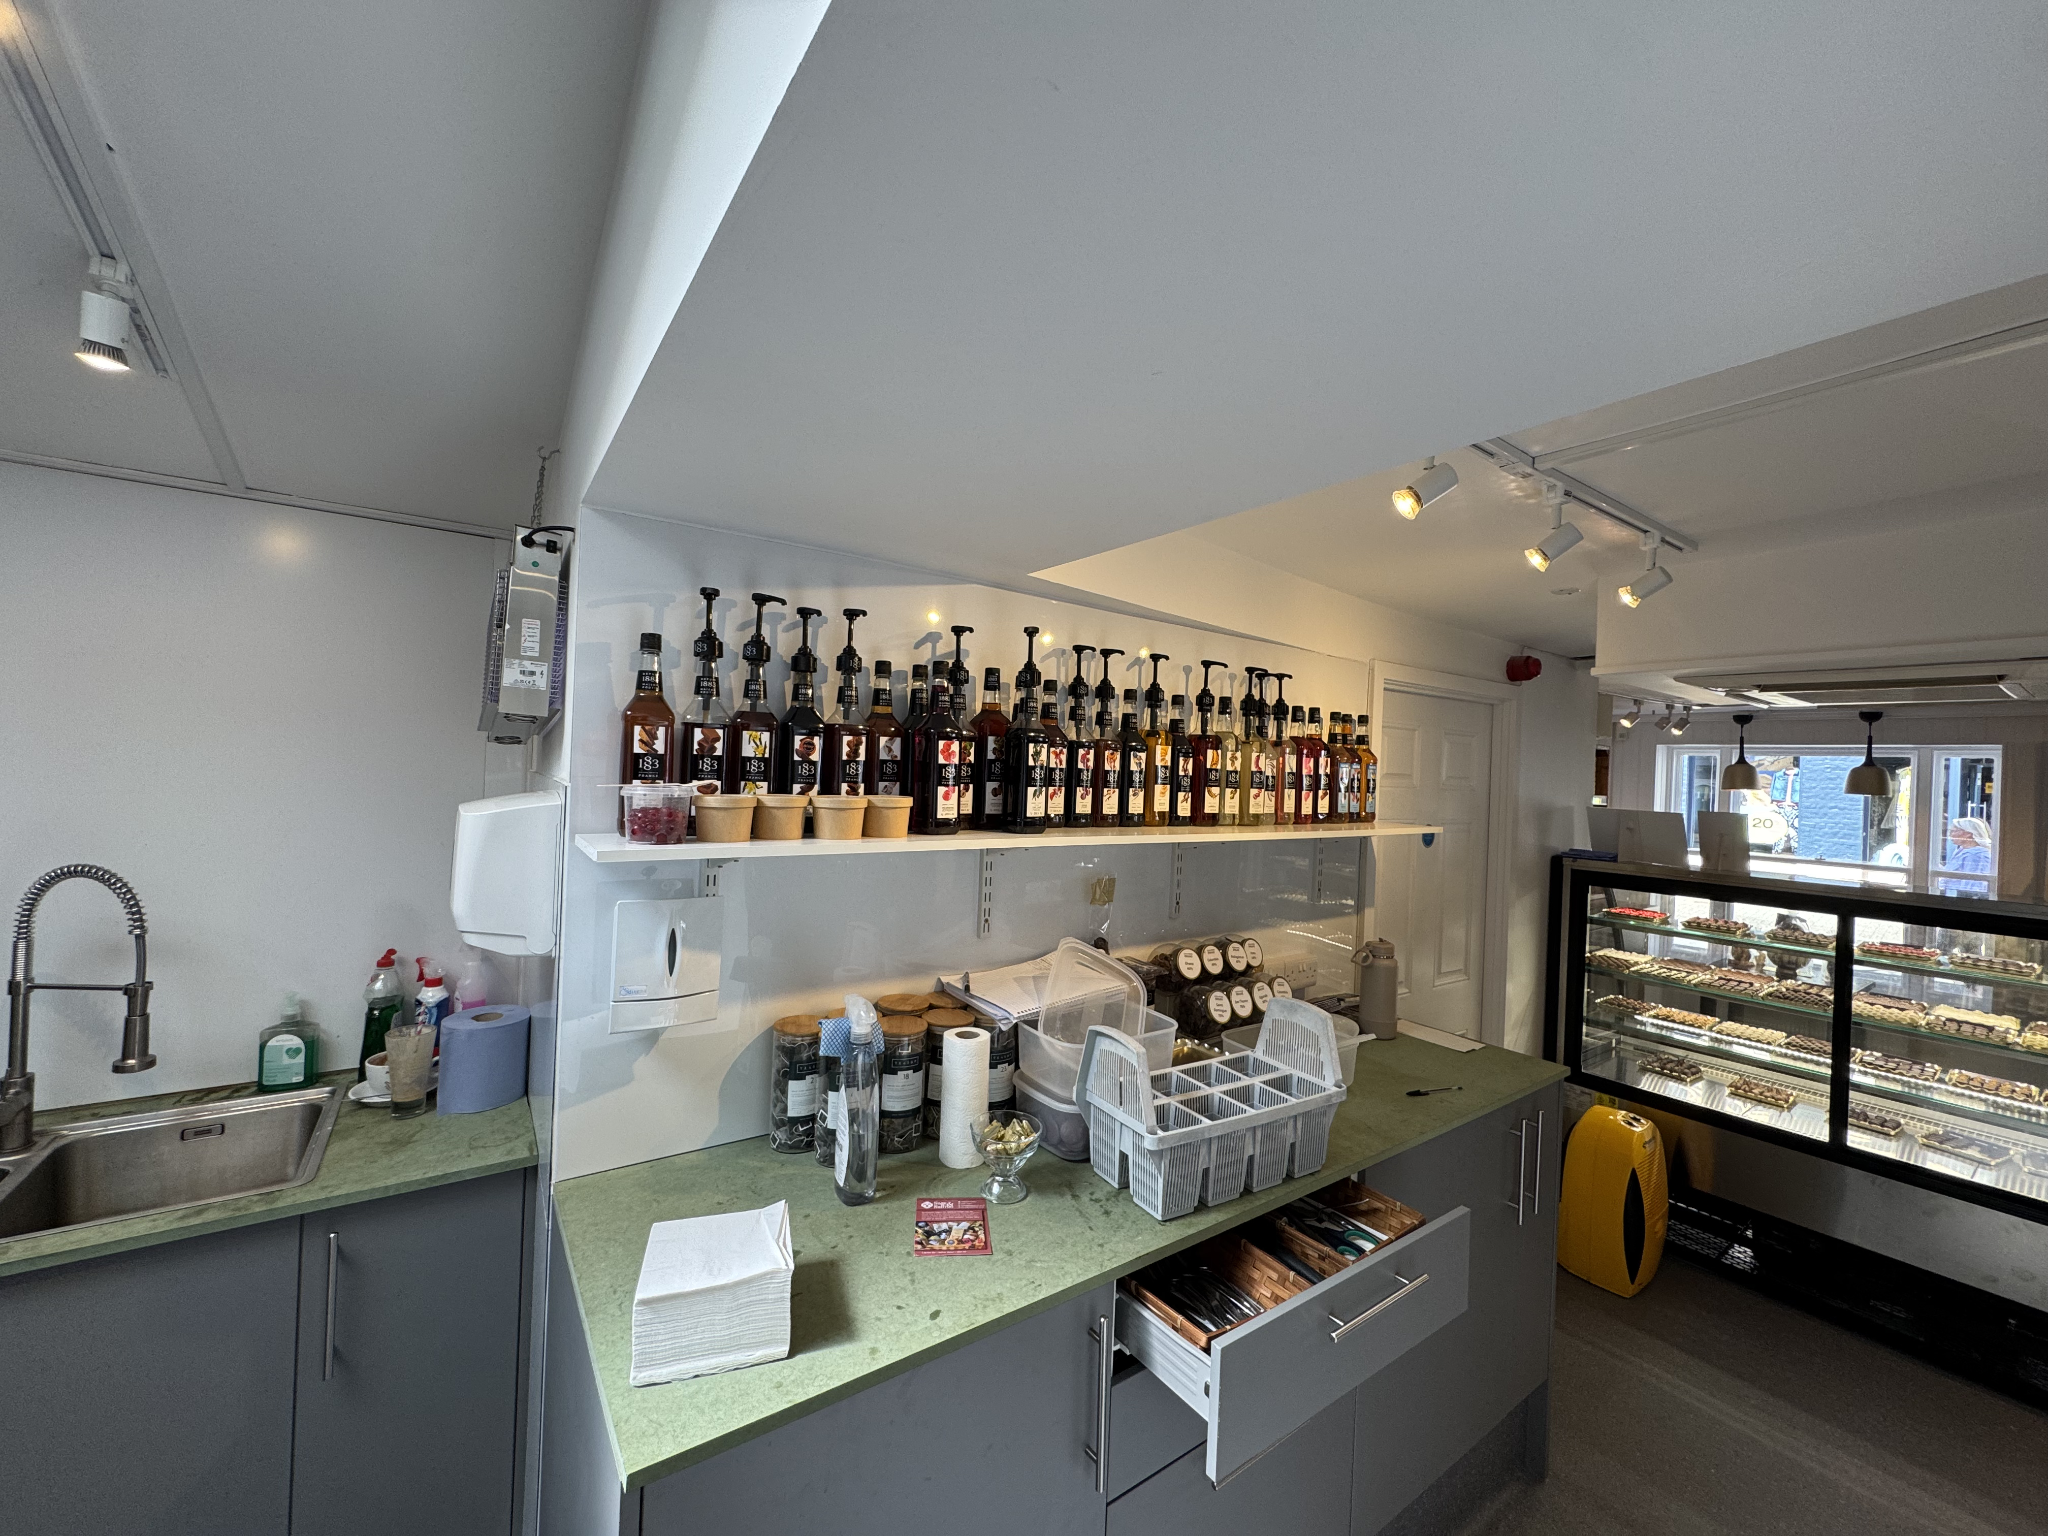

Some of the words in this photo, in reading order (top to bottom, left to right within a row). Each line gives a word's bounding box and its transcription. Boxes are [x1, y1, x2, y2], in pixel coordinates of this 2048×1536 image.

[638, 755, 659, 771] 1883
[698, 757, 718, 772] 1883
[746, 759, 765, 773] 1883
[798, 762, 815, 776] 1883
[1752, 817, 1773, 829] 20
